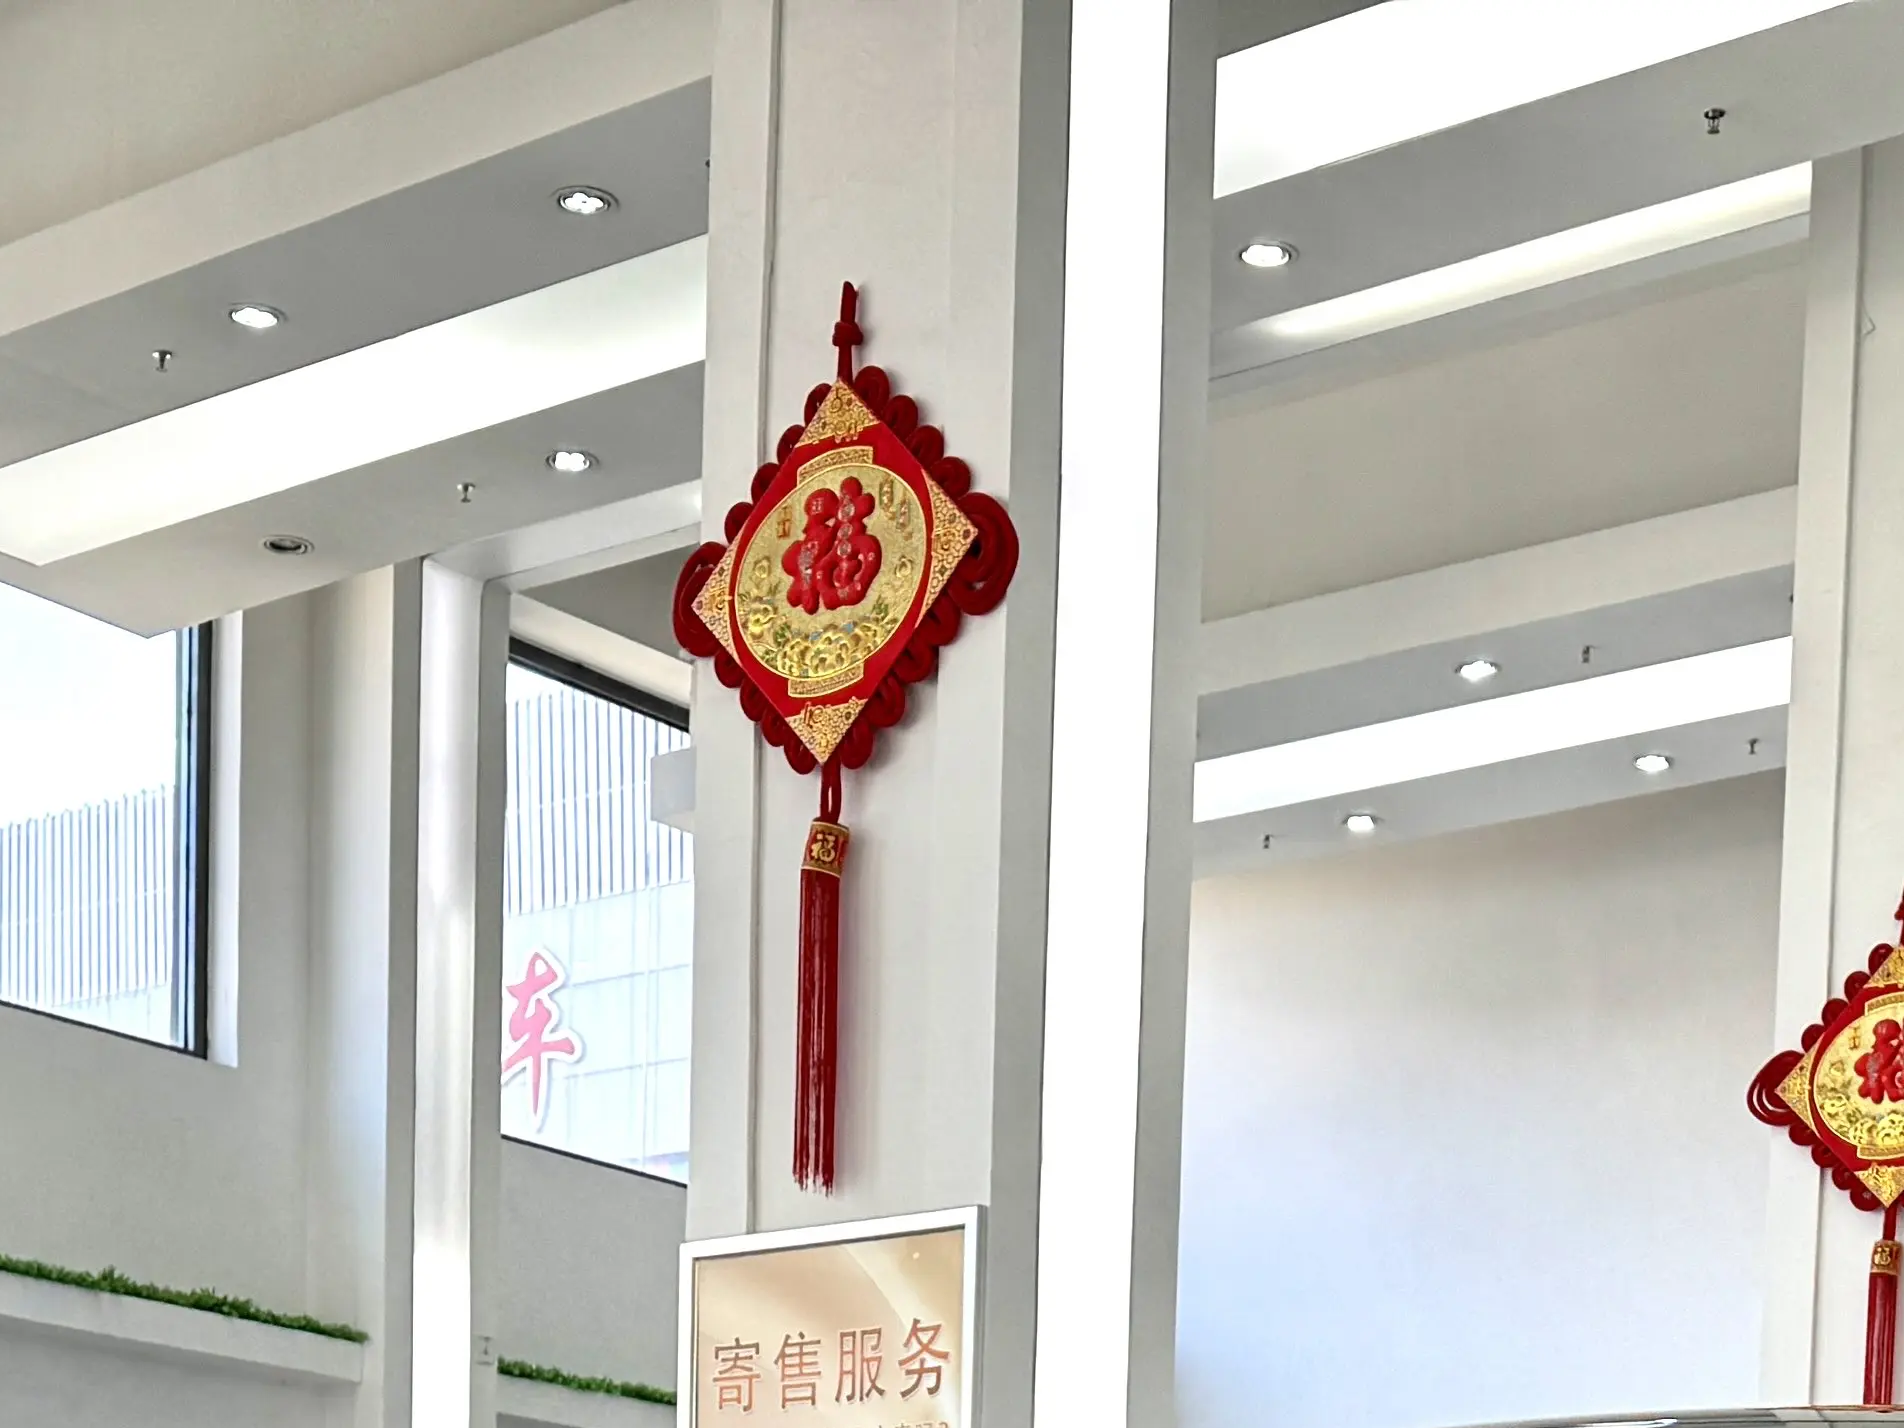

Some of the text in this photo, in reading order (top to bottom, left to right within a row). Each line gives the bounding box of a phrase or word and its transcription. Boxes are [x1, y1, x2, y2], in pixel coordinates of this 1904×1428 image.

[782, 476, 883, 616] 福
[811, 833, 836, 862] 福
[712, 1318, 952, 1415] 寄售服务
